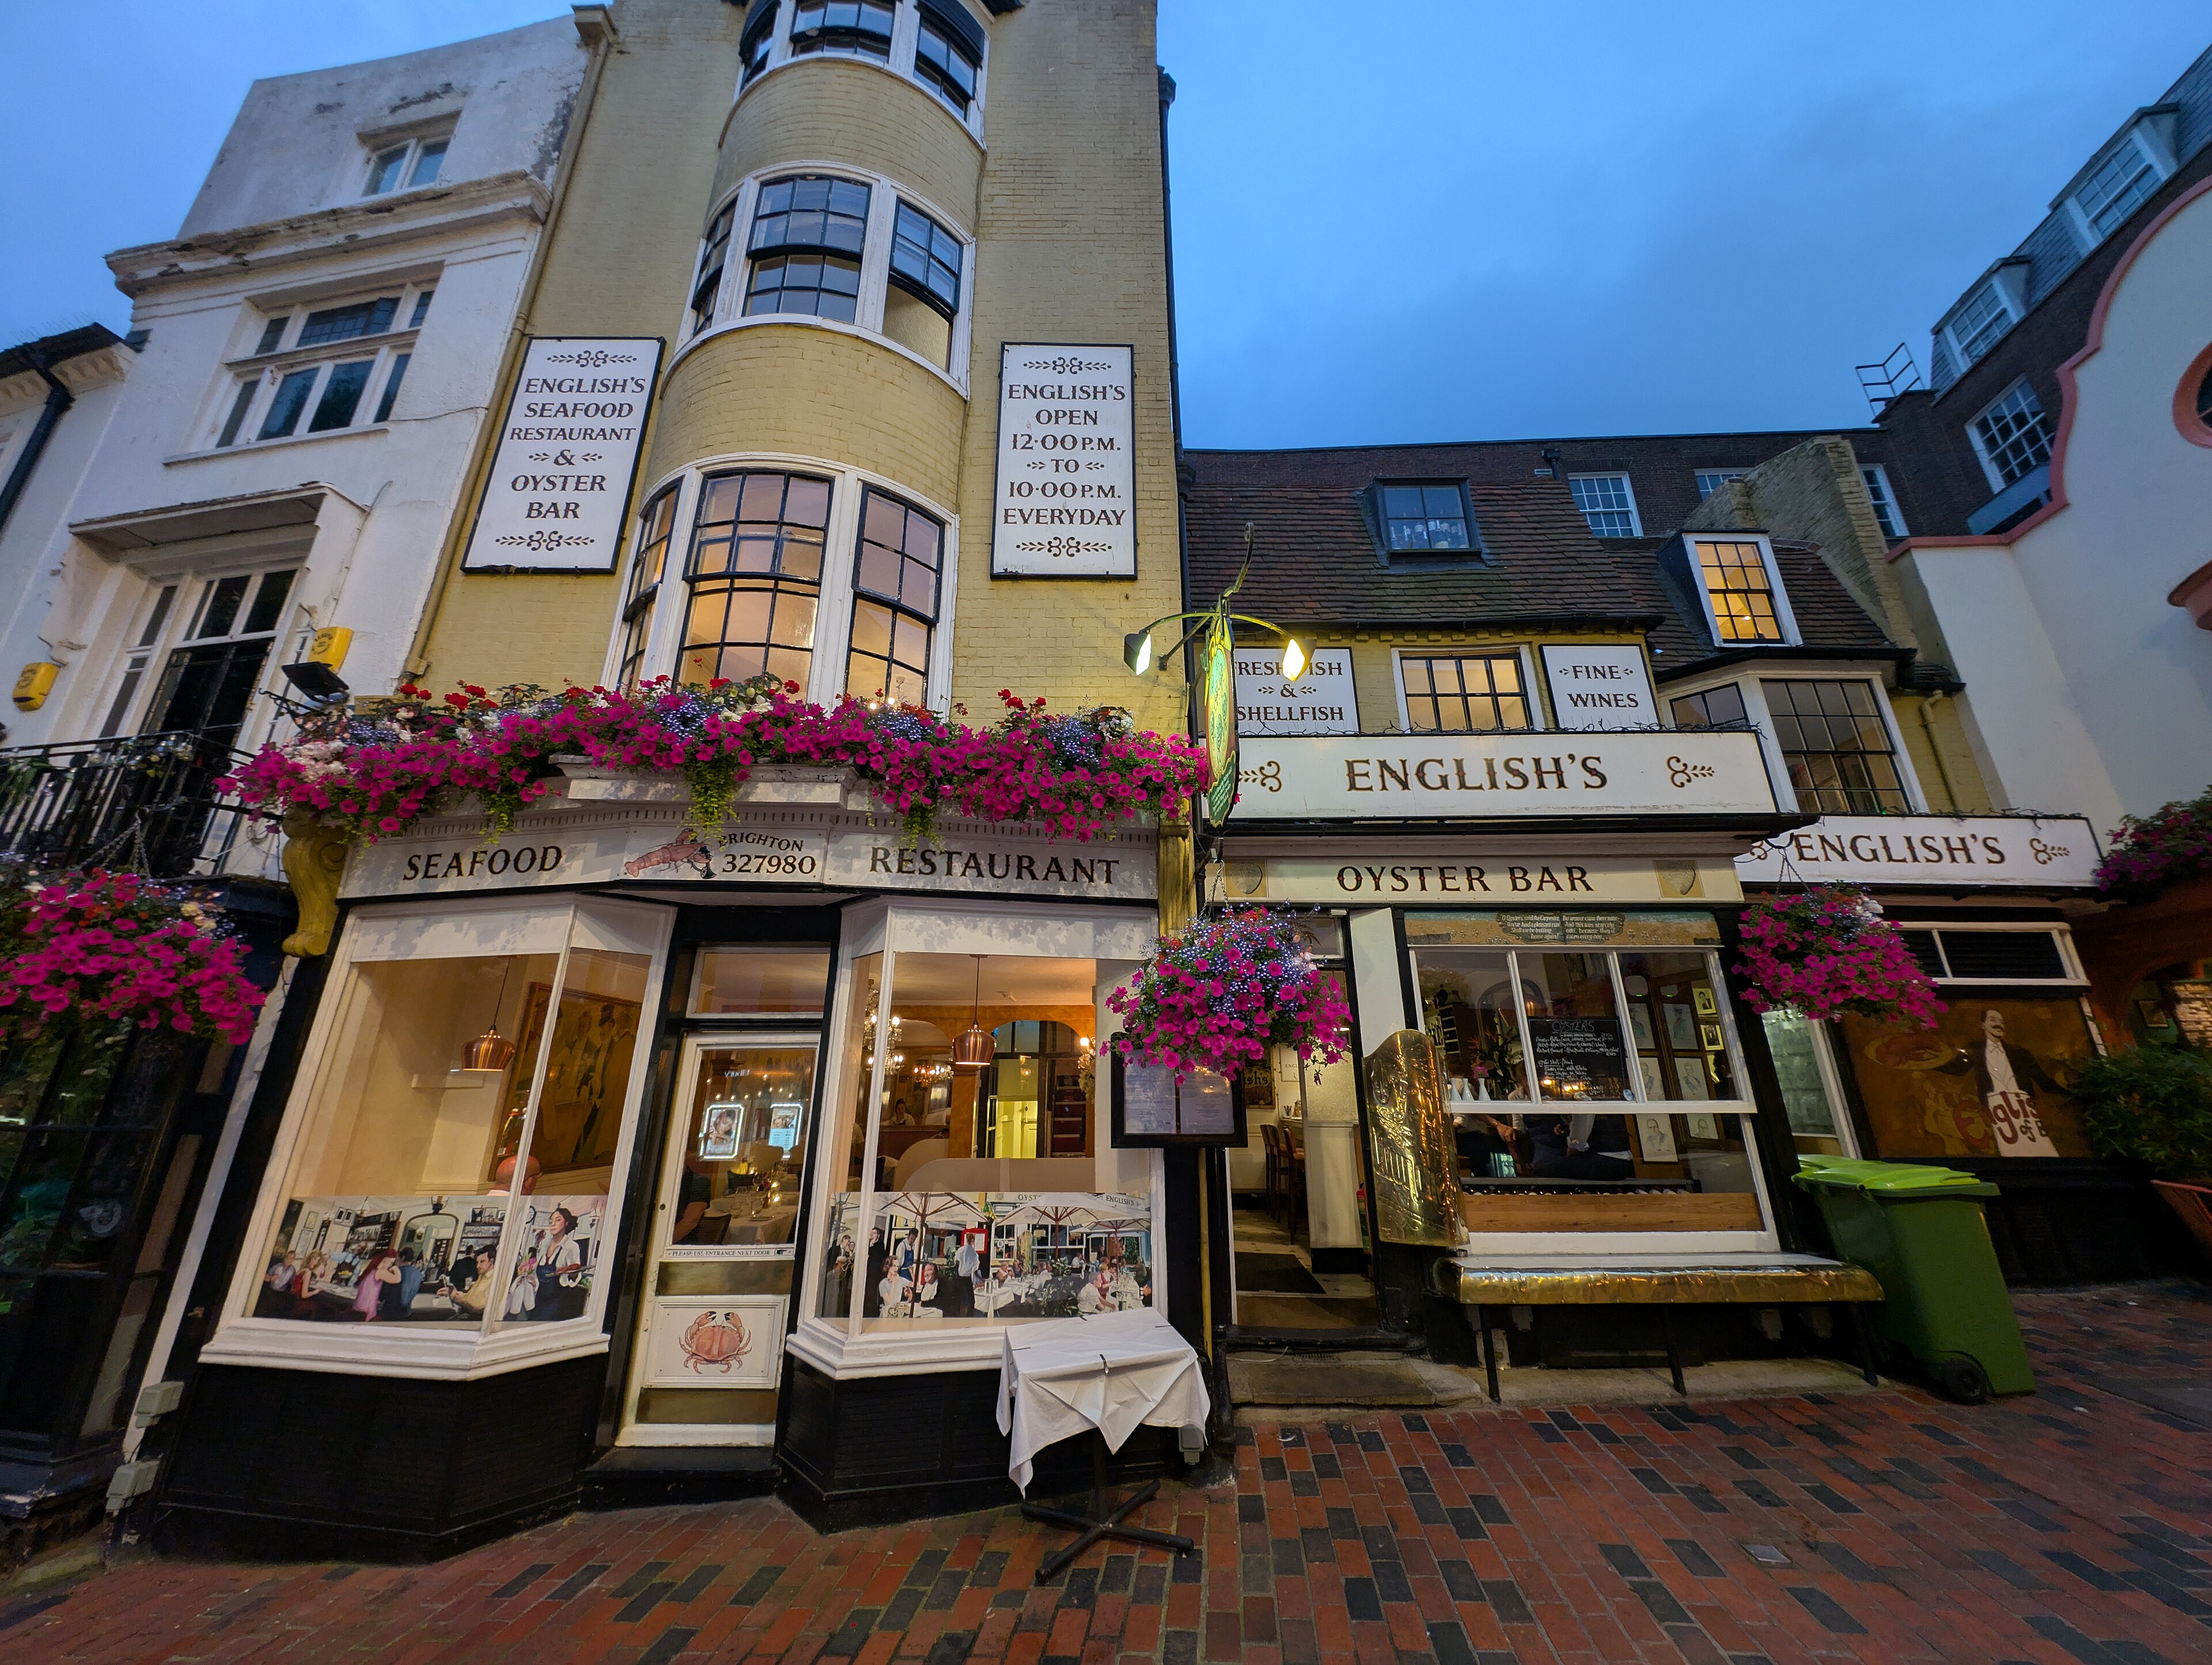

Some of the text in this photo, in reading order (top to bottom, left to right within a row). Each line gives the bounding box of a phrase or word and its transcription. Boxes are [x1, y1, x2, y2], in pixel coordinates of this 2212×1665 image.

[524, 377, 646, 394] ENGLISH'S
[1007, 384, 1126, 401] ENGLISH'S
[524, 402, 633, 418] SEAFOOD
[1035, 409, 1099, 426] OPEN
[509, 427, 636, 441] RESTAURANT
[553, 449, 576, 466] &
[1051, 458, 1080, 473] TO
[510, 475, 607, 491] OYSTER
[525, 502, 580, 519] BAR
[1003, 508, 1127, 526] EVERYDAY
[1235, 661, 1343, 676] RESH ISH
[1571, 665, 1620, 680] FINE
[1280, 684, 1298, 698] &
[1567, 692, 1639, 708] WINES
[1237, 706, 1344, 721] SHELLFISH
[1344, 752, 1608, 792] ENGLISH'S
[718, 832, 804, 852] BRIGHTON
[1793, 832, 2006, 864] ENGLISH'S
[403, 845, 562, 881] SEAFOOD
[722, 854, 817, 874] 327980
[869, 845, 1120, 885] RESTAURANT
[1336, 865, 1594, 892] OYSTER BAR
[1552, 1021, 1594, 1033] OYSTERS
[1106, 1195, 1134, 1206] ENGLISH'S
